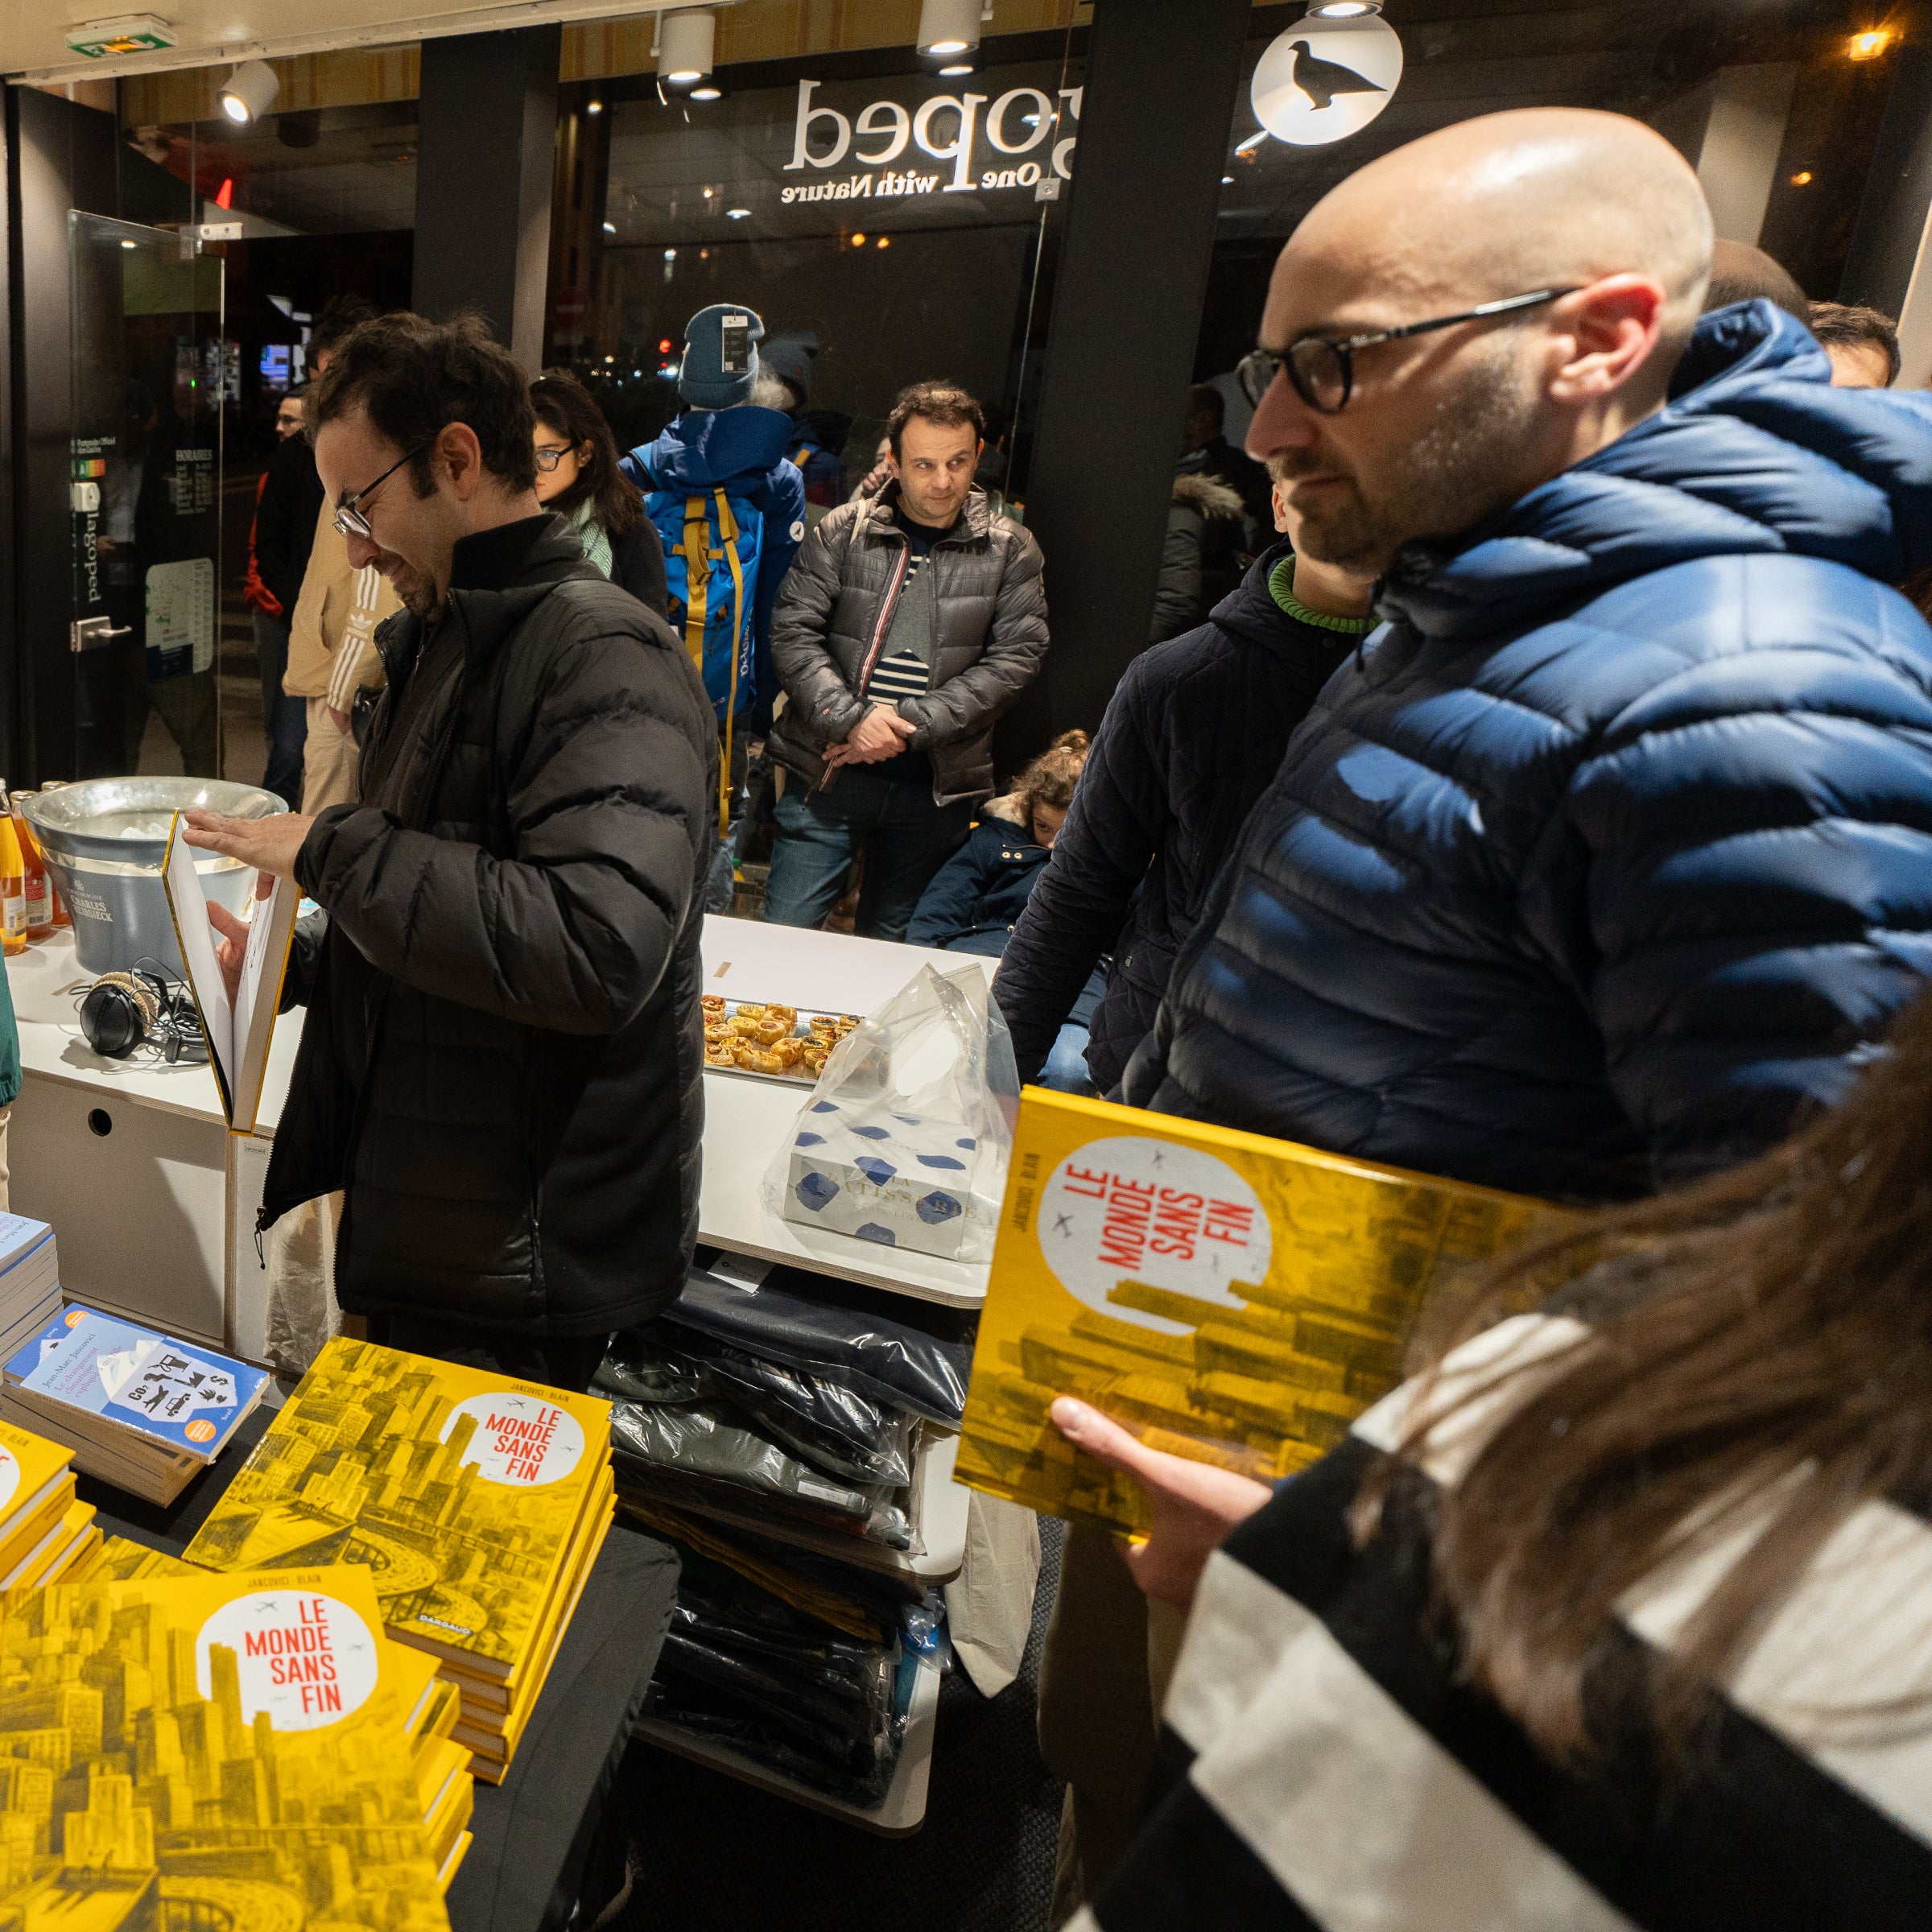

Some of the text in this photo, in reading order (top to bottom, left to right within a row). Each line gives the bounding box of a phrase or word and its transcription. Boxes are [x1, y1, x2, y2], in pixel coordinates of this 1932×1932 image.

[83, 510, 101, 604] lagoped
[1063, 1162, 1109, 1199] LE
[1096, 1174, 1156, 1271] MONDE
[1149, 1187, 1204, 1261] SANS
[1203, 1198, 1255, 1247] FIN
[42, 1357, 73, 1389] Jean-Marc
[69, 1332, 97, 1360] Jancovici
[54, 1382, 66, 1392] Le
[64, 1347, 99, 1383] changement
[65, 1363, 96, 1395] climatique
[74, 1370, 100, 1399] expliqué
[549, 1391, 570, 1403] BLAIN
[485, 1413, 555, 1445] MONDE
[537, 1407, 563, 1427] LE
[493, 1435, 547, 1463] SANS
[506, 1458, 540, 1482] FIN
[297, 1574, 322, 1585] BLAIN
[299, 1599, 328, 1624] LE
[419, 1614, 472, 1635] DARGAUD
[245, 1625, 332, 1657] MONDE
[270, 1653, 336, 1685] SANS
[300, 1683, 342, 1714] FIN
